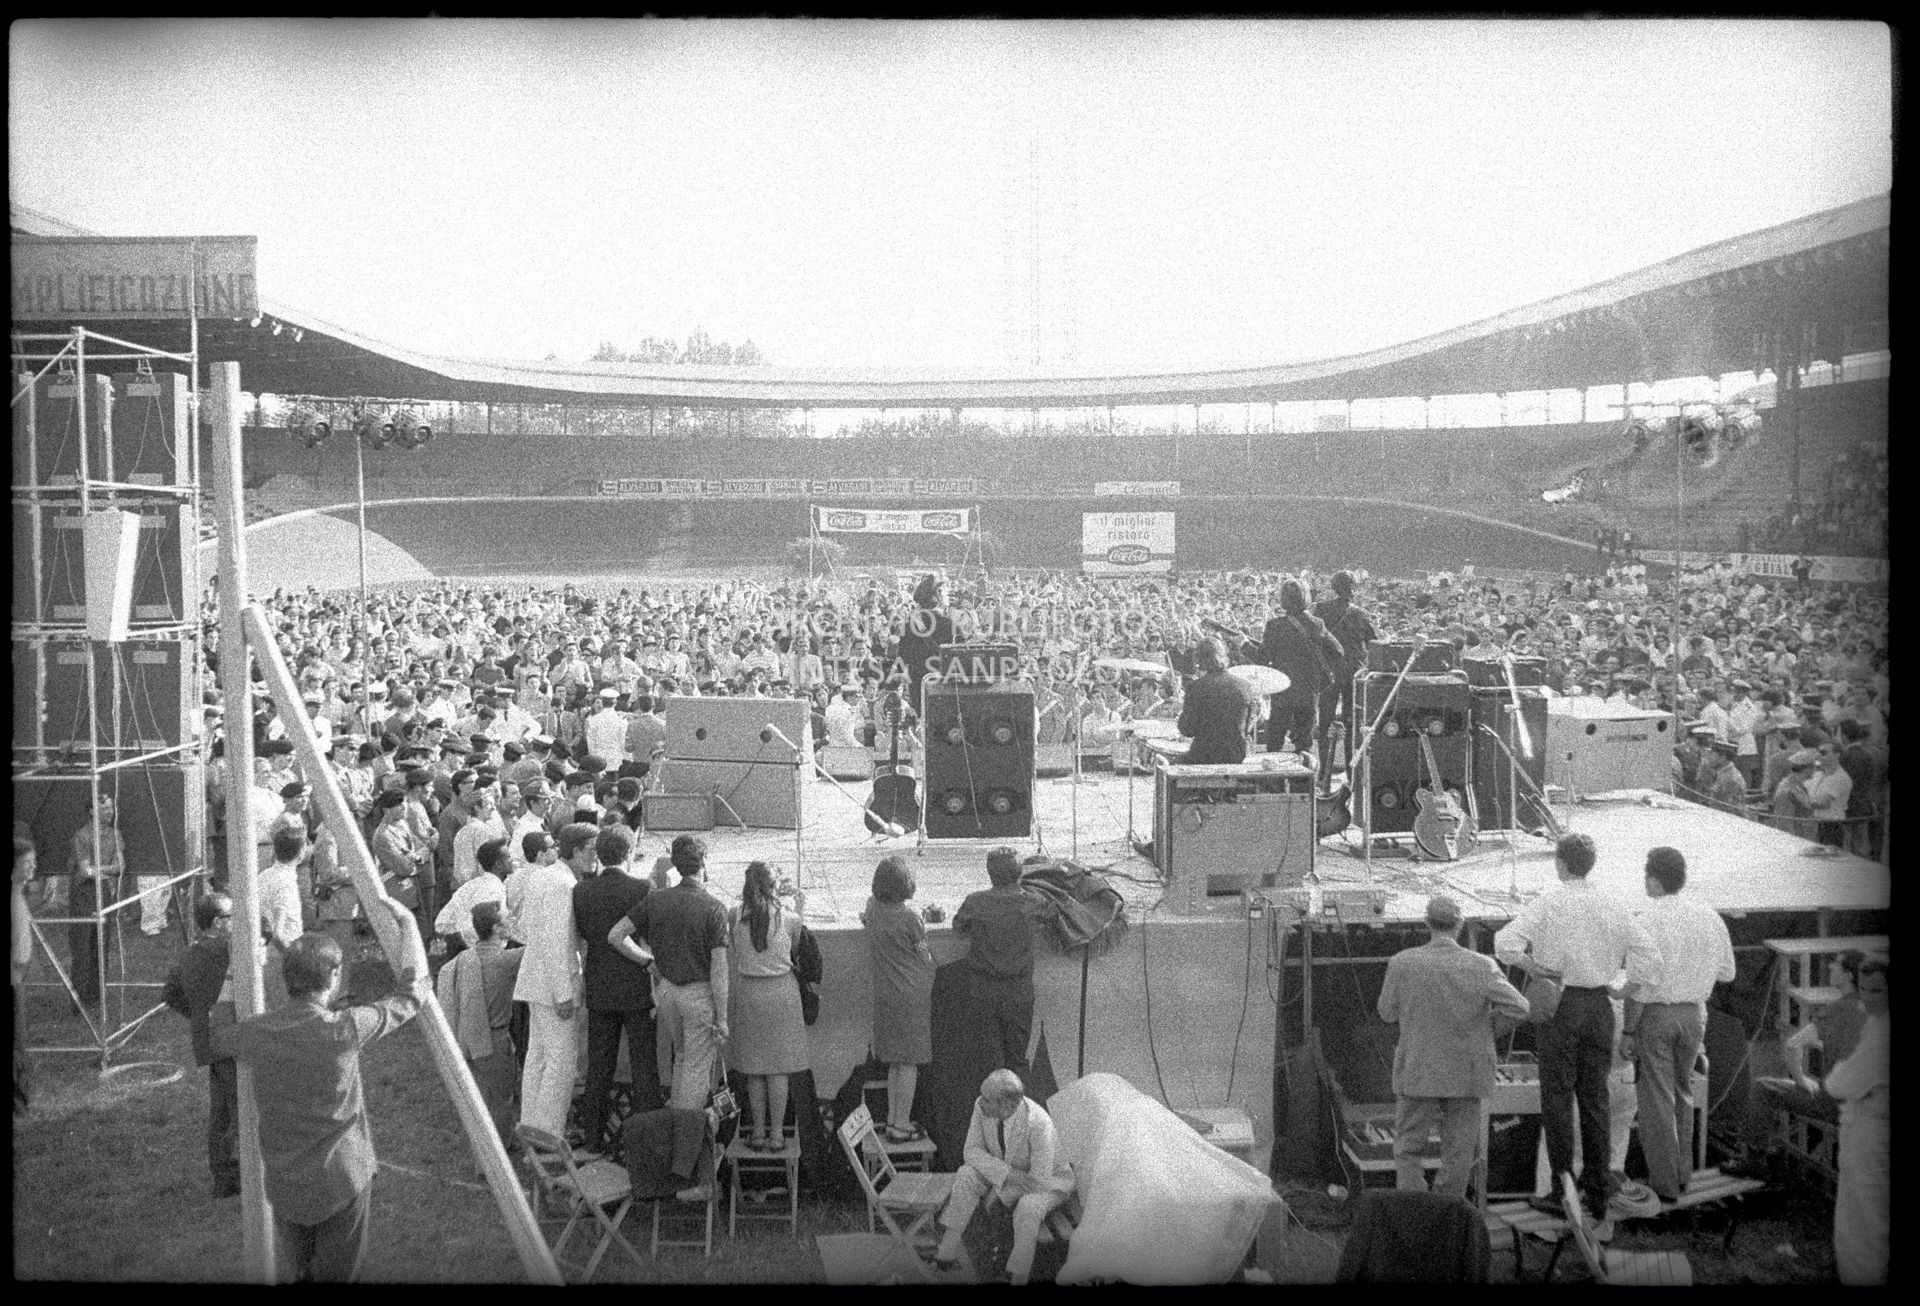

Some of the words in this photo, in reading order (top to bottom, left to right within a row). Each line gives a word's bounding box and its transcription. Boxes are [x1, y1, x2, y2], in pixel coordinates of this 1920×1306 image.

[1100, 515, 1108, 526] il
[1114, 514, 1157, 530] miglior
[1107, 530, 1151, 541] ristoro
